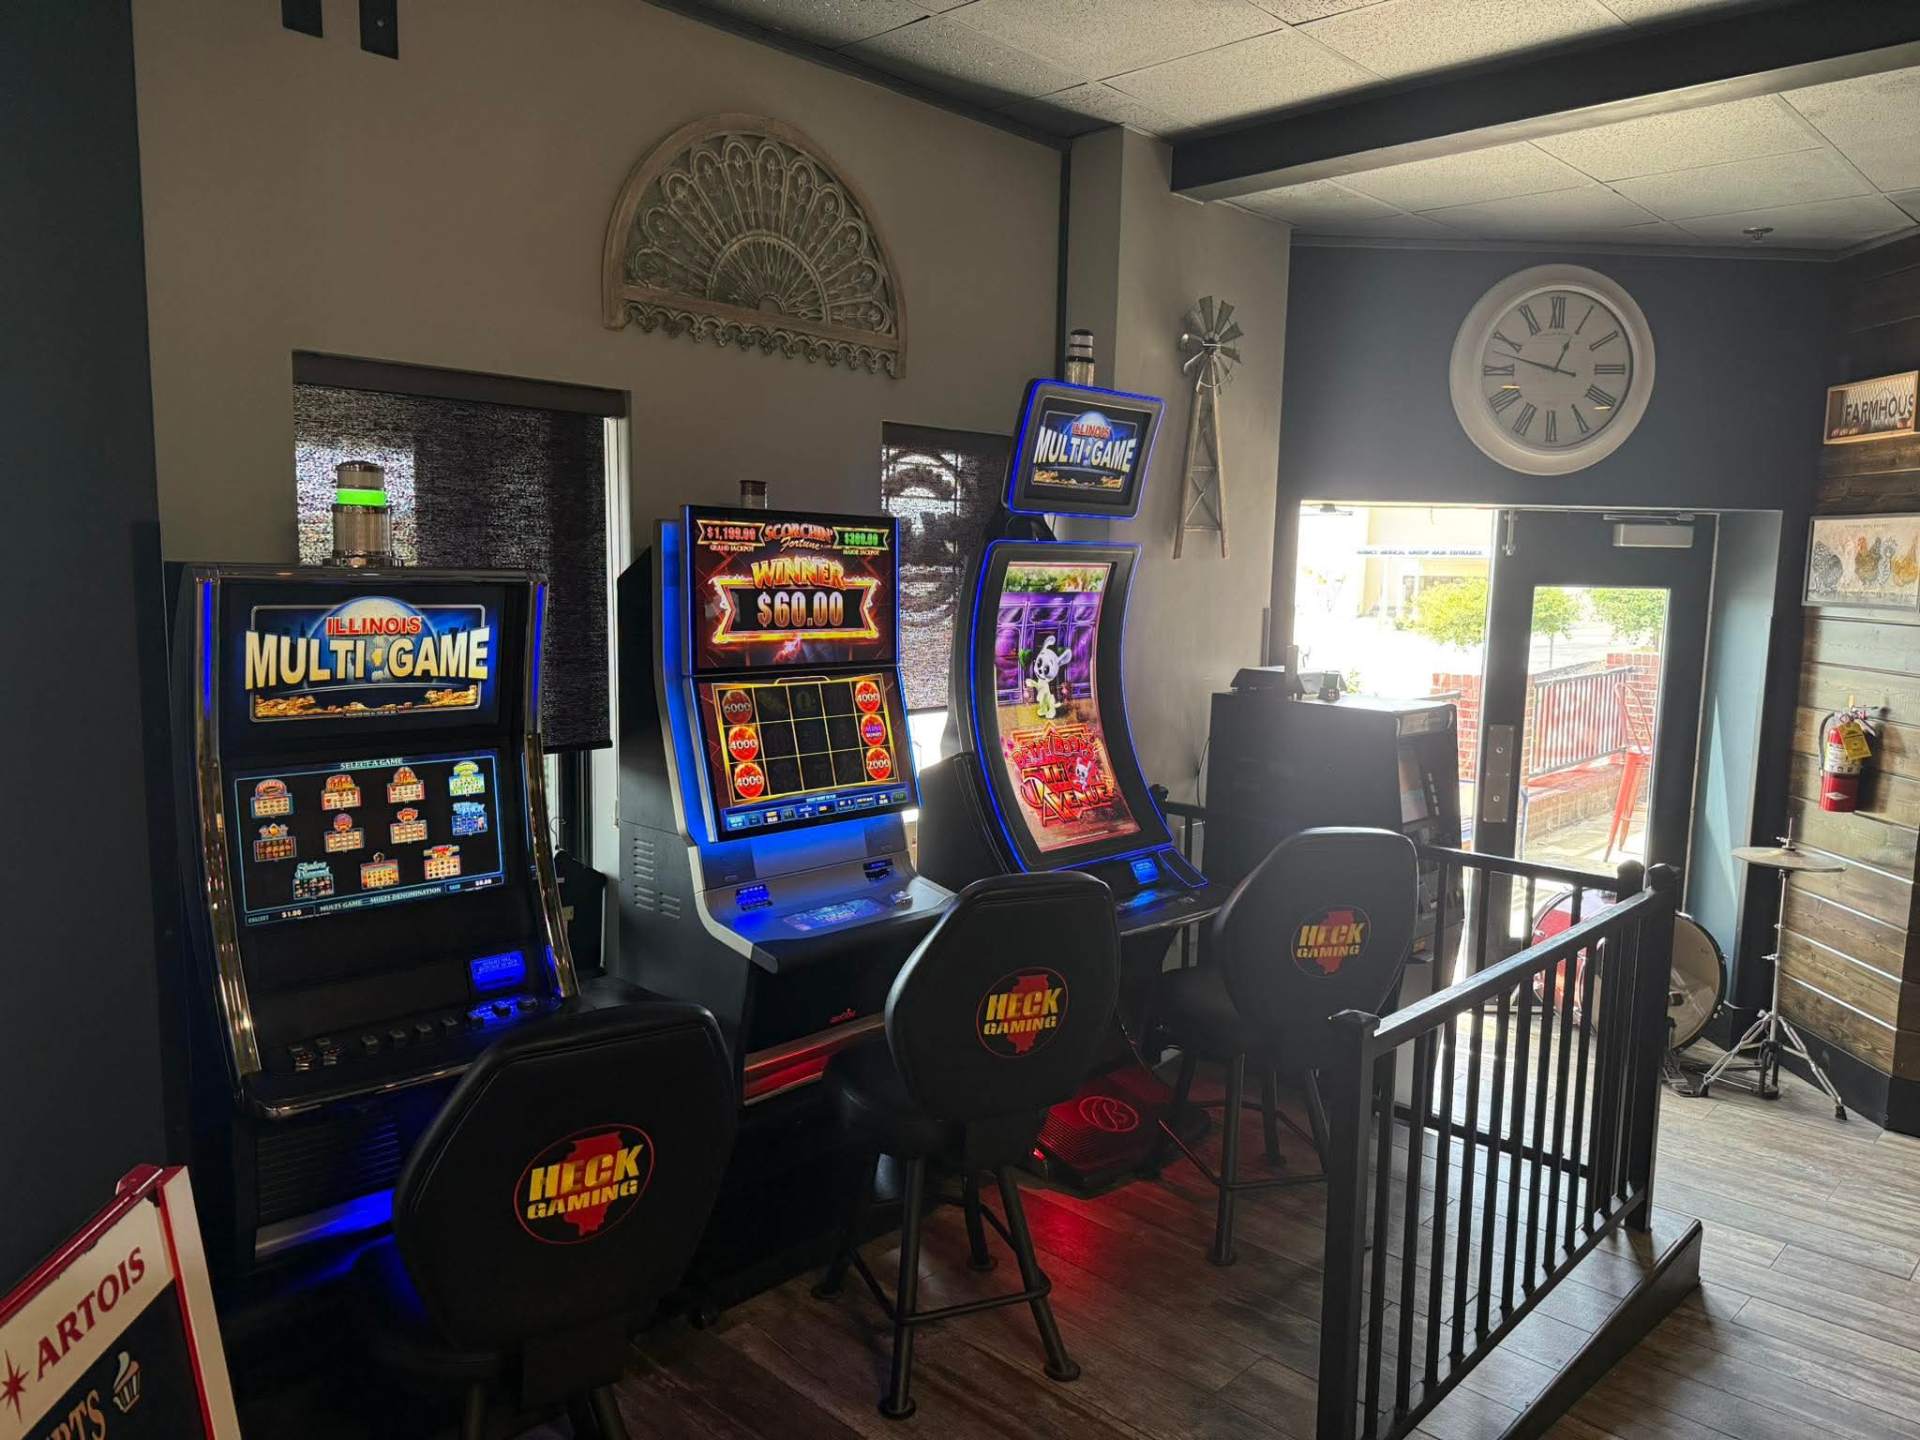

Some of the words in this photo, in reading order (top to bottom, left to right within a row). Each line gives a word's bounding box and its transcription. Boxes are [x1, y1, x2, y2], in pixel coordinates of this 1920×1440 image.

[1550, 296, 1567, 329] XII
[1072, 421, 1112, 439] ILLINOIS
[1033, 425, 1086, 464] MULTI
[1091, 438, 1138, 473] GAME
[731, 545, 755, 553] JACKPOT
[780, 537, 822, 551] Fortune
[751, 557, 848, 591] WINNER
[757, 591, 844, 629] $60.00
[325, 615, 423, 636] ILLINOIS
[245, 629, 366, 691] MULTI
[388, 626, 490, 681] GAME
[856, 693, 880, 703] 4000
[729, 739, 758, 751] 4000
[866, 760, 890, 770] 2000
[736, 774, 763, 786] 4000
[1042, 783, 1113, 827] AVENUE
[1299, 922, 1366, 947] HECK
[1296, 944, 1360, 959] GAMING
[986, 987, 1063, 1021] HECK
[983, 1015, 1057, 1035] GAMING
[529, 1143, 645, 1203] HECK
[527, 1179, 639, 1220] GAMING
[36, 1245, 146, 1383] ARTOIS
